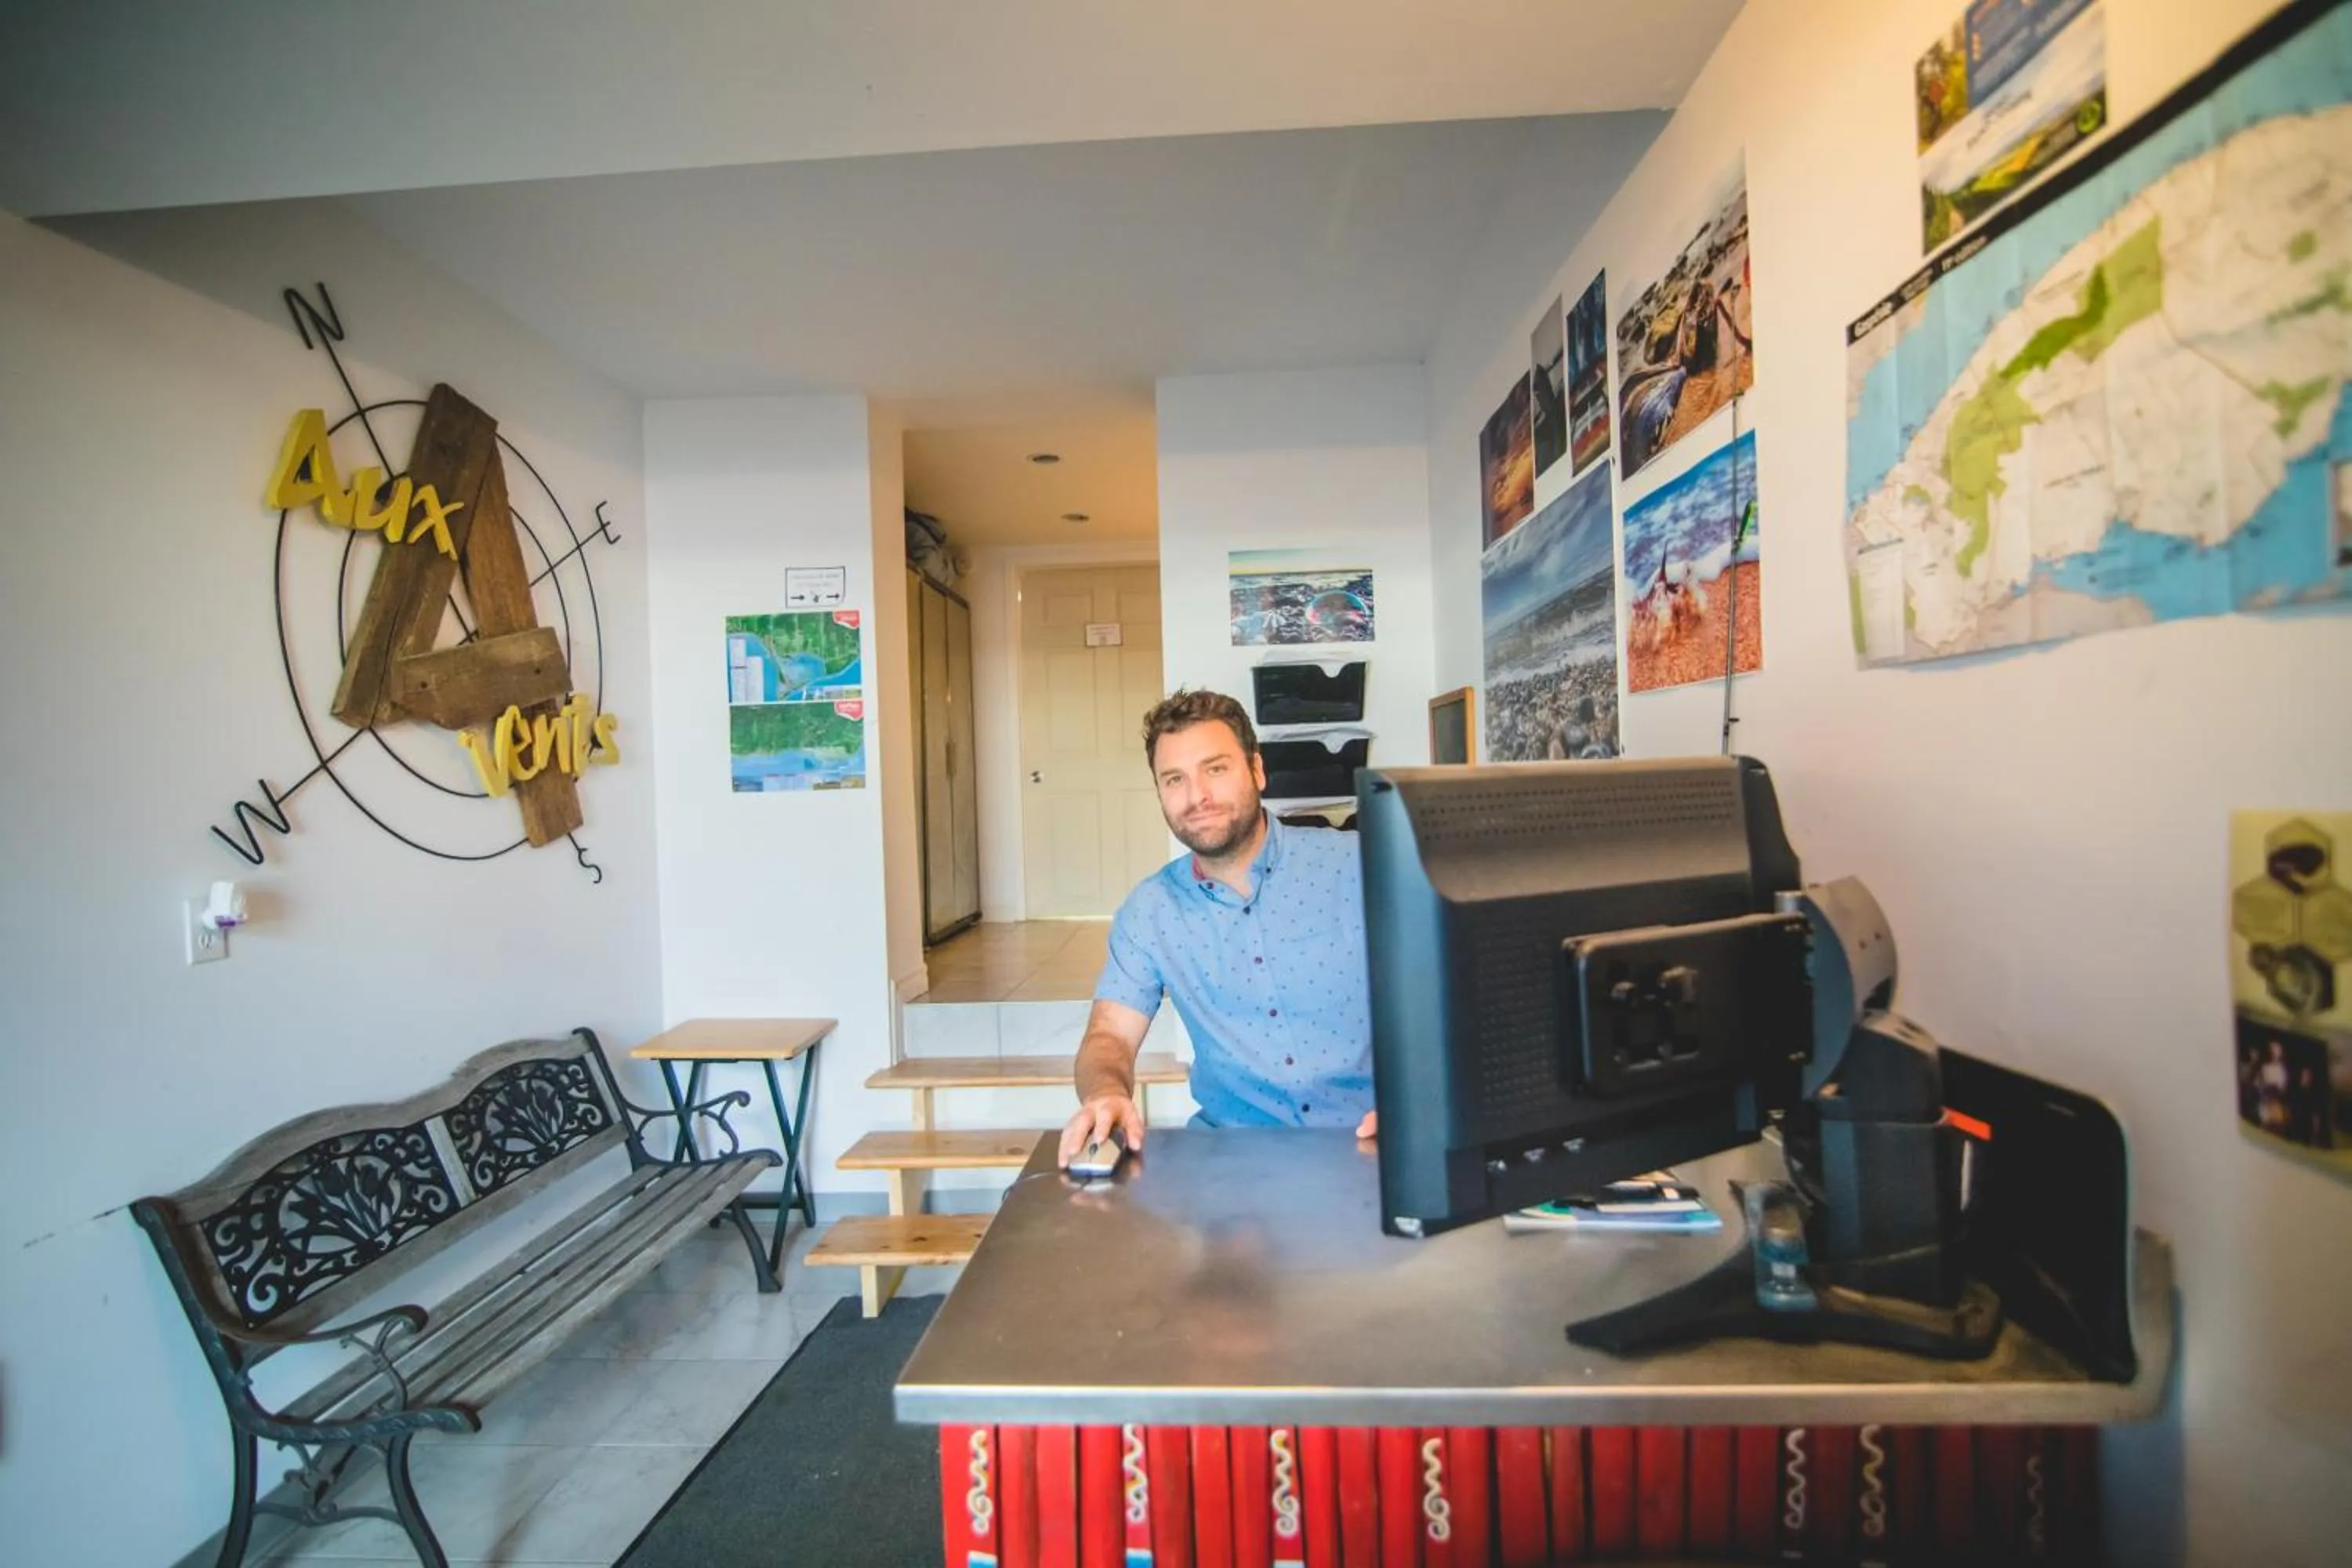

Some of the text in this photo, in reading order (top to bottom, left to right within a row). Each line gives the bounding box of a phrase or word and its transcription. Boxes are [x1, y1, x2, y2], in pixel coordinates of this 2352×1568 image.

[284, 281, 344, 350] N
[264, 408, 465, 561] Aux
[595, 500, 622, 544] E
[458, 692, 621, 797] Vents
[210, 779, 291, 864] W
